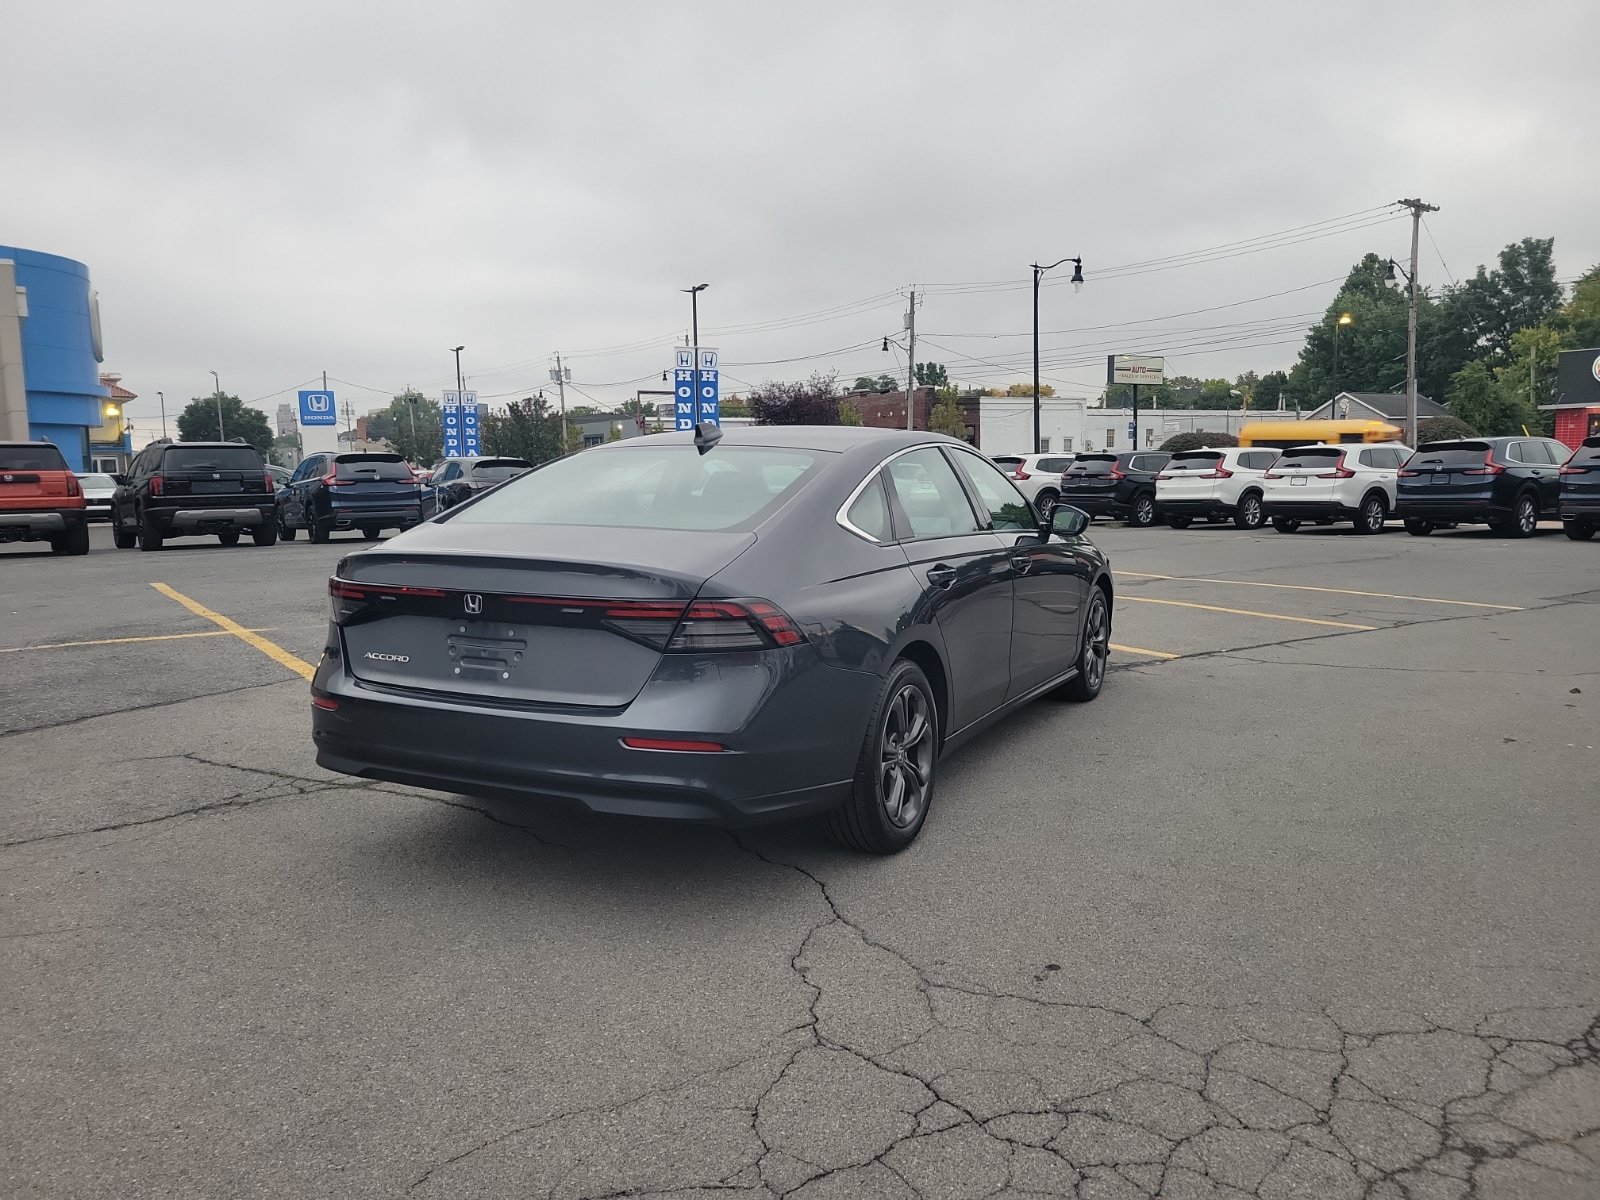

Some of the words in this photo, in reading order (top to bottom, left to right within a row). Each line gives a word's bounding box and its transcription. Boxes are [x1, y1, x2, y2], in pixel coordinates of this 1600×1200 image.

[677, 370, 692, 430] HOND
[445, 406, 459, 457] HONDA
[464, 406, 478, 457] HONDA
[364, 651, 410, 663] ACCORD
